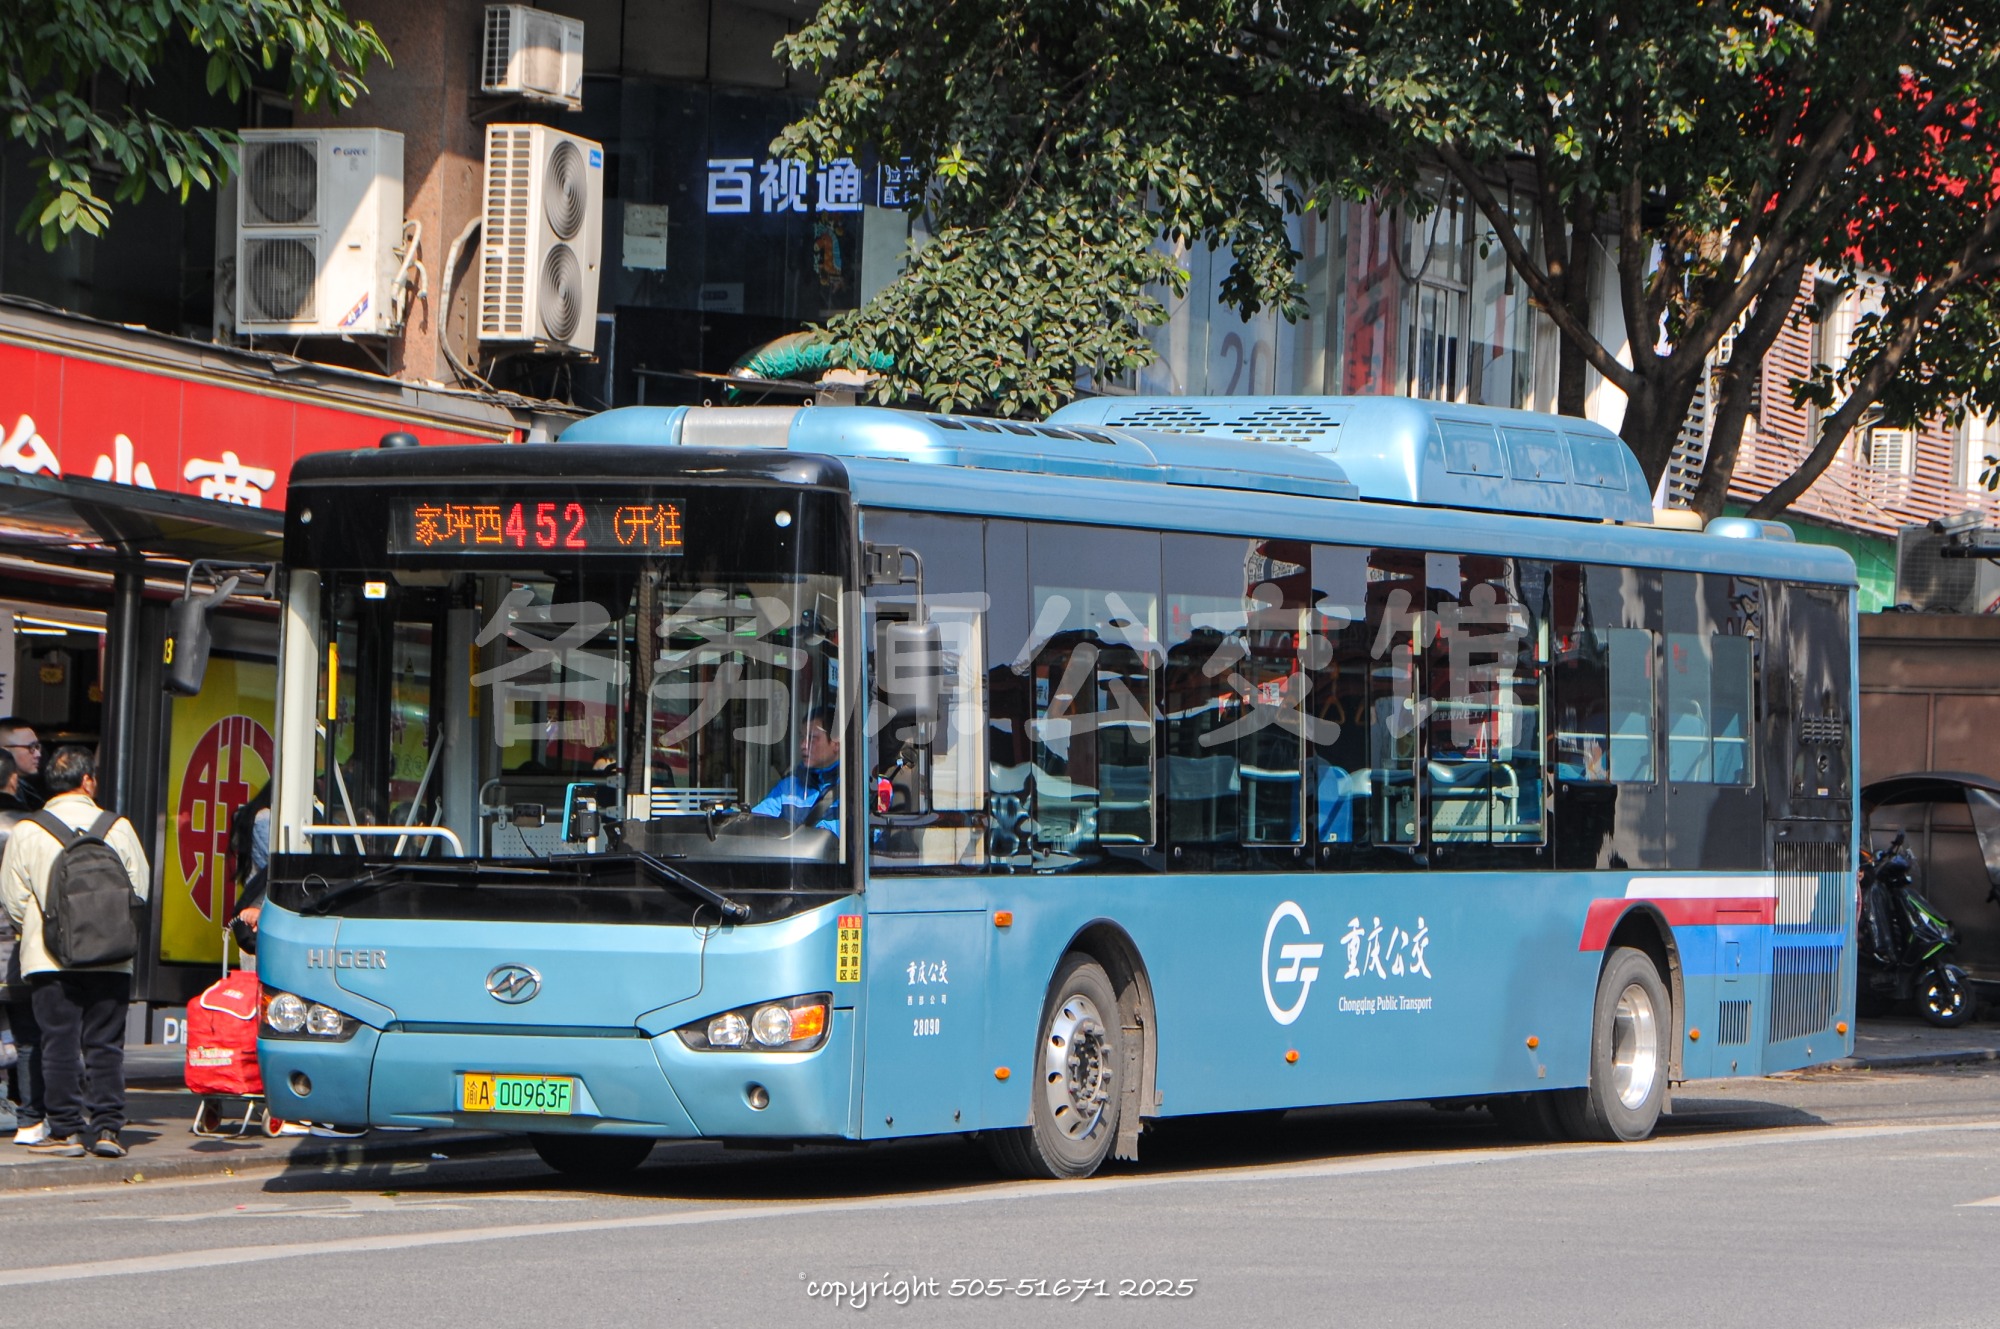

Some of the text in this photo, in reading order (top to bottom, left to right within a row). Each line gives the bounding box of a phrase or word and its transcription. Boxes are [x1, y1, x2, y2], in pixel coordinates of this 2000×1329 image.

[707, 157, 863, 213] 百视通
[505, 503, 587, 548] 452
[307, 948, 387, 969] HIGER
[840, 929, 849, 981] 视线盲区
[850, 929, 859, 981] 请勿靠近
[1339, 916, 1433, 981] 重庆公交
[906, 959, 949, 987] 重庆公交
[1338, 996, 1433, 1015] Chongqing Public Transport
[913, 1018, 940, 1037] 28090
[466, 1081, 570, 1109] 渝A 00963F
